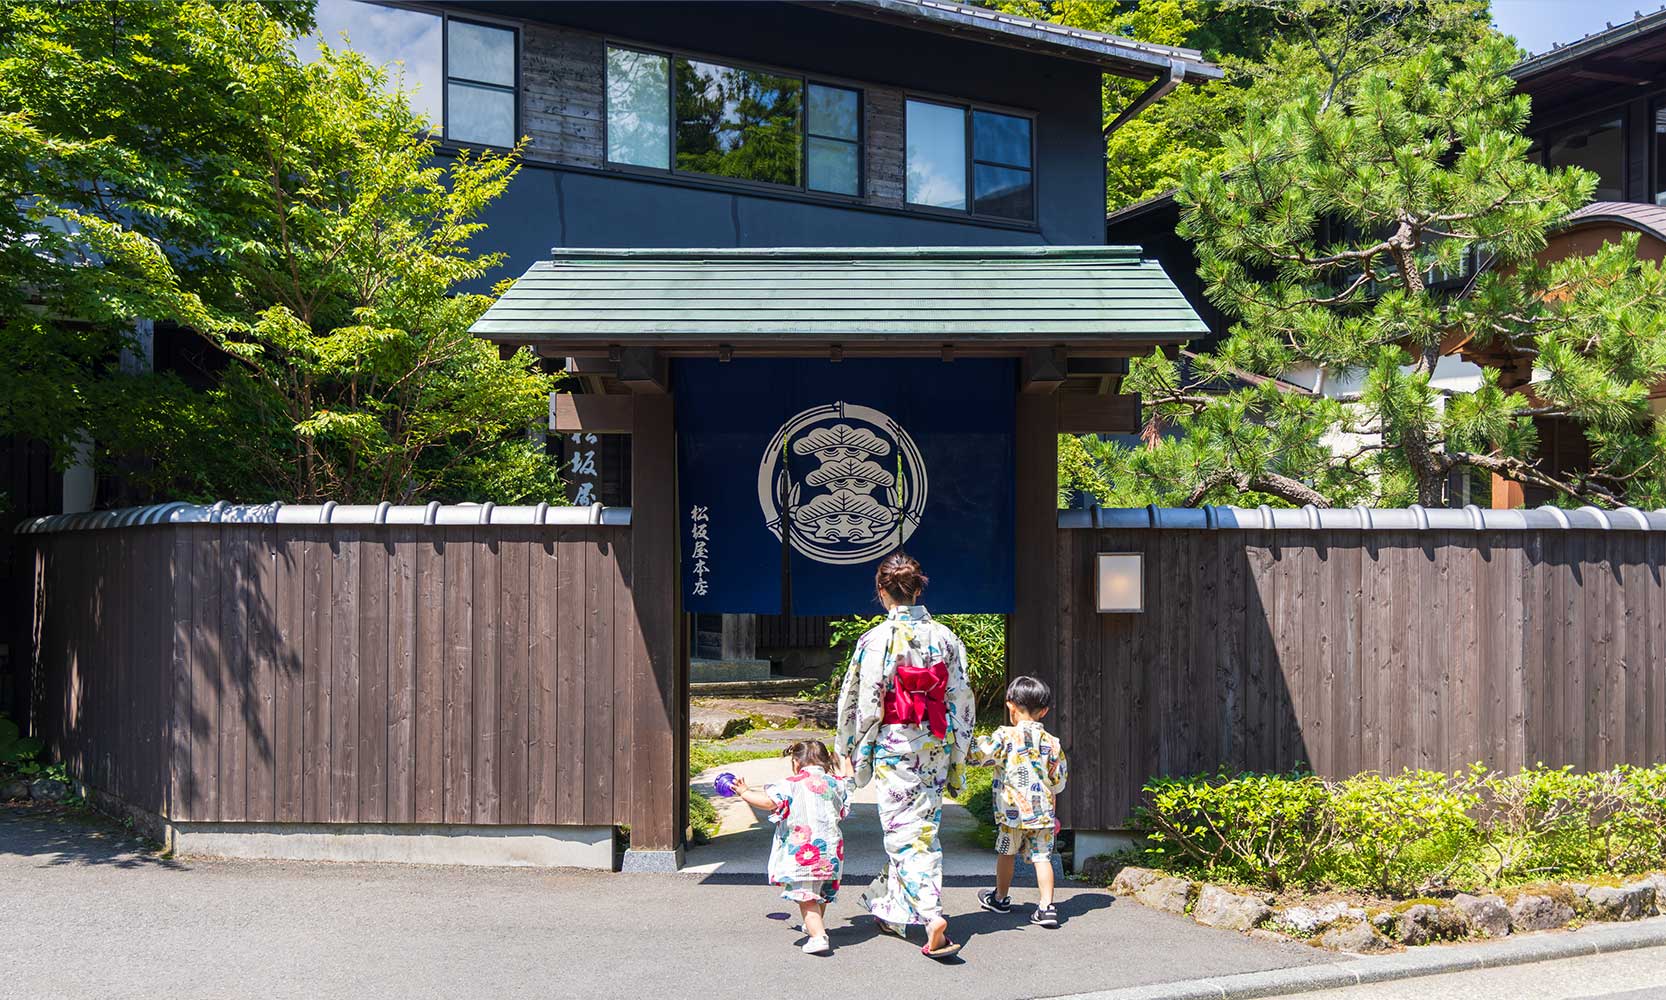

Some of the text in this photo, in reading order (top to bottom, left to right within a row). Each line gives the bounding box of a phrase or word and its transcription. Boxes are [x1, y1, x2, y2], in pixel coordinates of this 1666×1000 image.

[691, 504, 710, 596] 松坂屋本店
